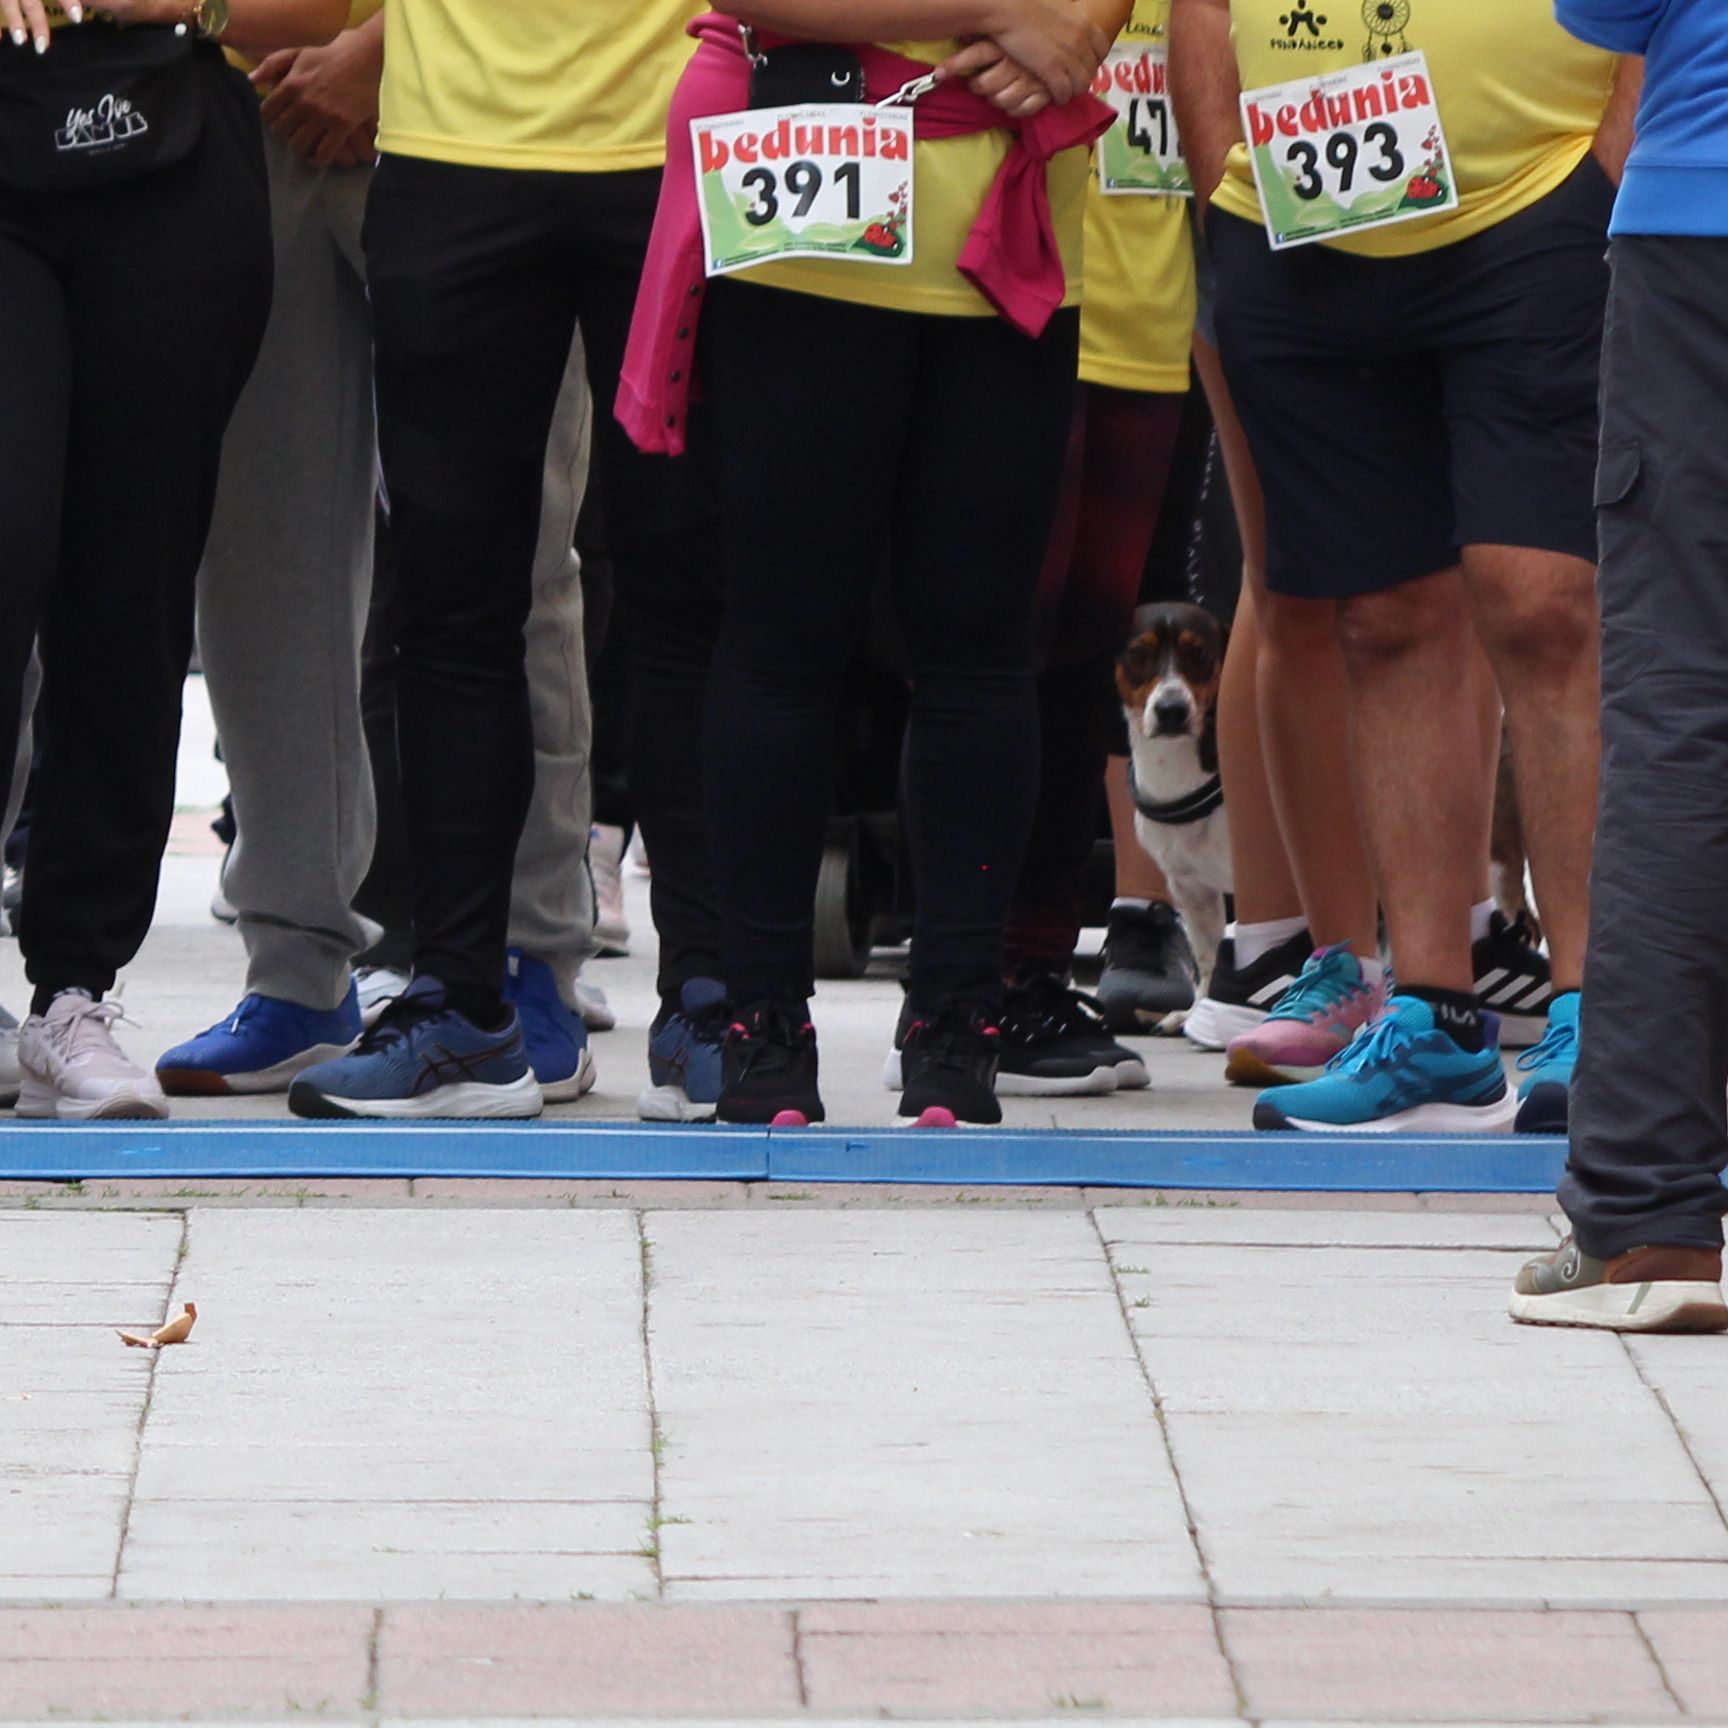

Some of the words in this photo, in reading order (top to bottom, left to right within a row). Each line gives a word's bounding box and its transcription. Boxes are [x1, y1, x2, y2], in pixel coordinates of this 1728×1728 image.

[1128, 98, 1185, 157] 47
[1246, 69, 1432, 148] bedunia
[698, 116, 909, 175] bedunia
[1286, 121, 1406, 201] 393
[741, 159, 861, 227] 391
